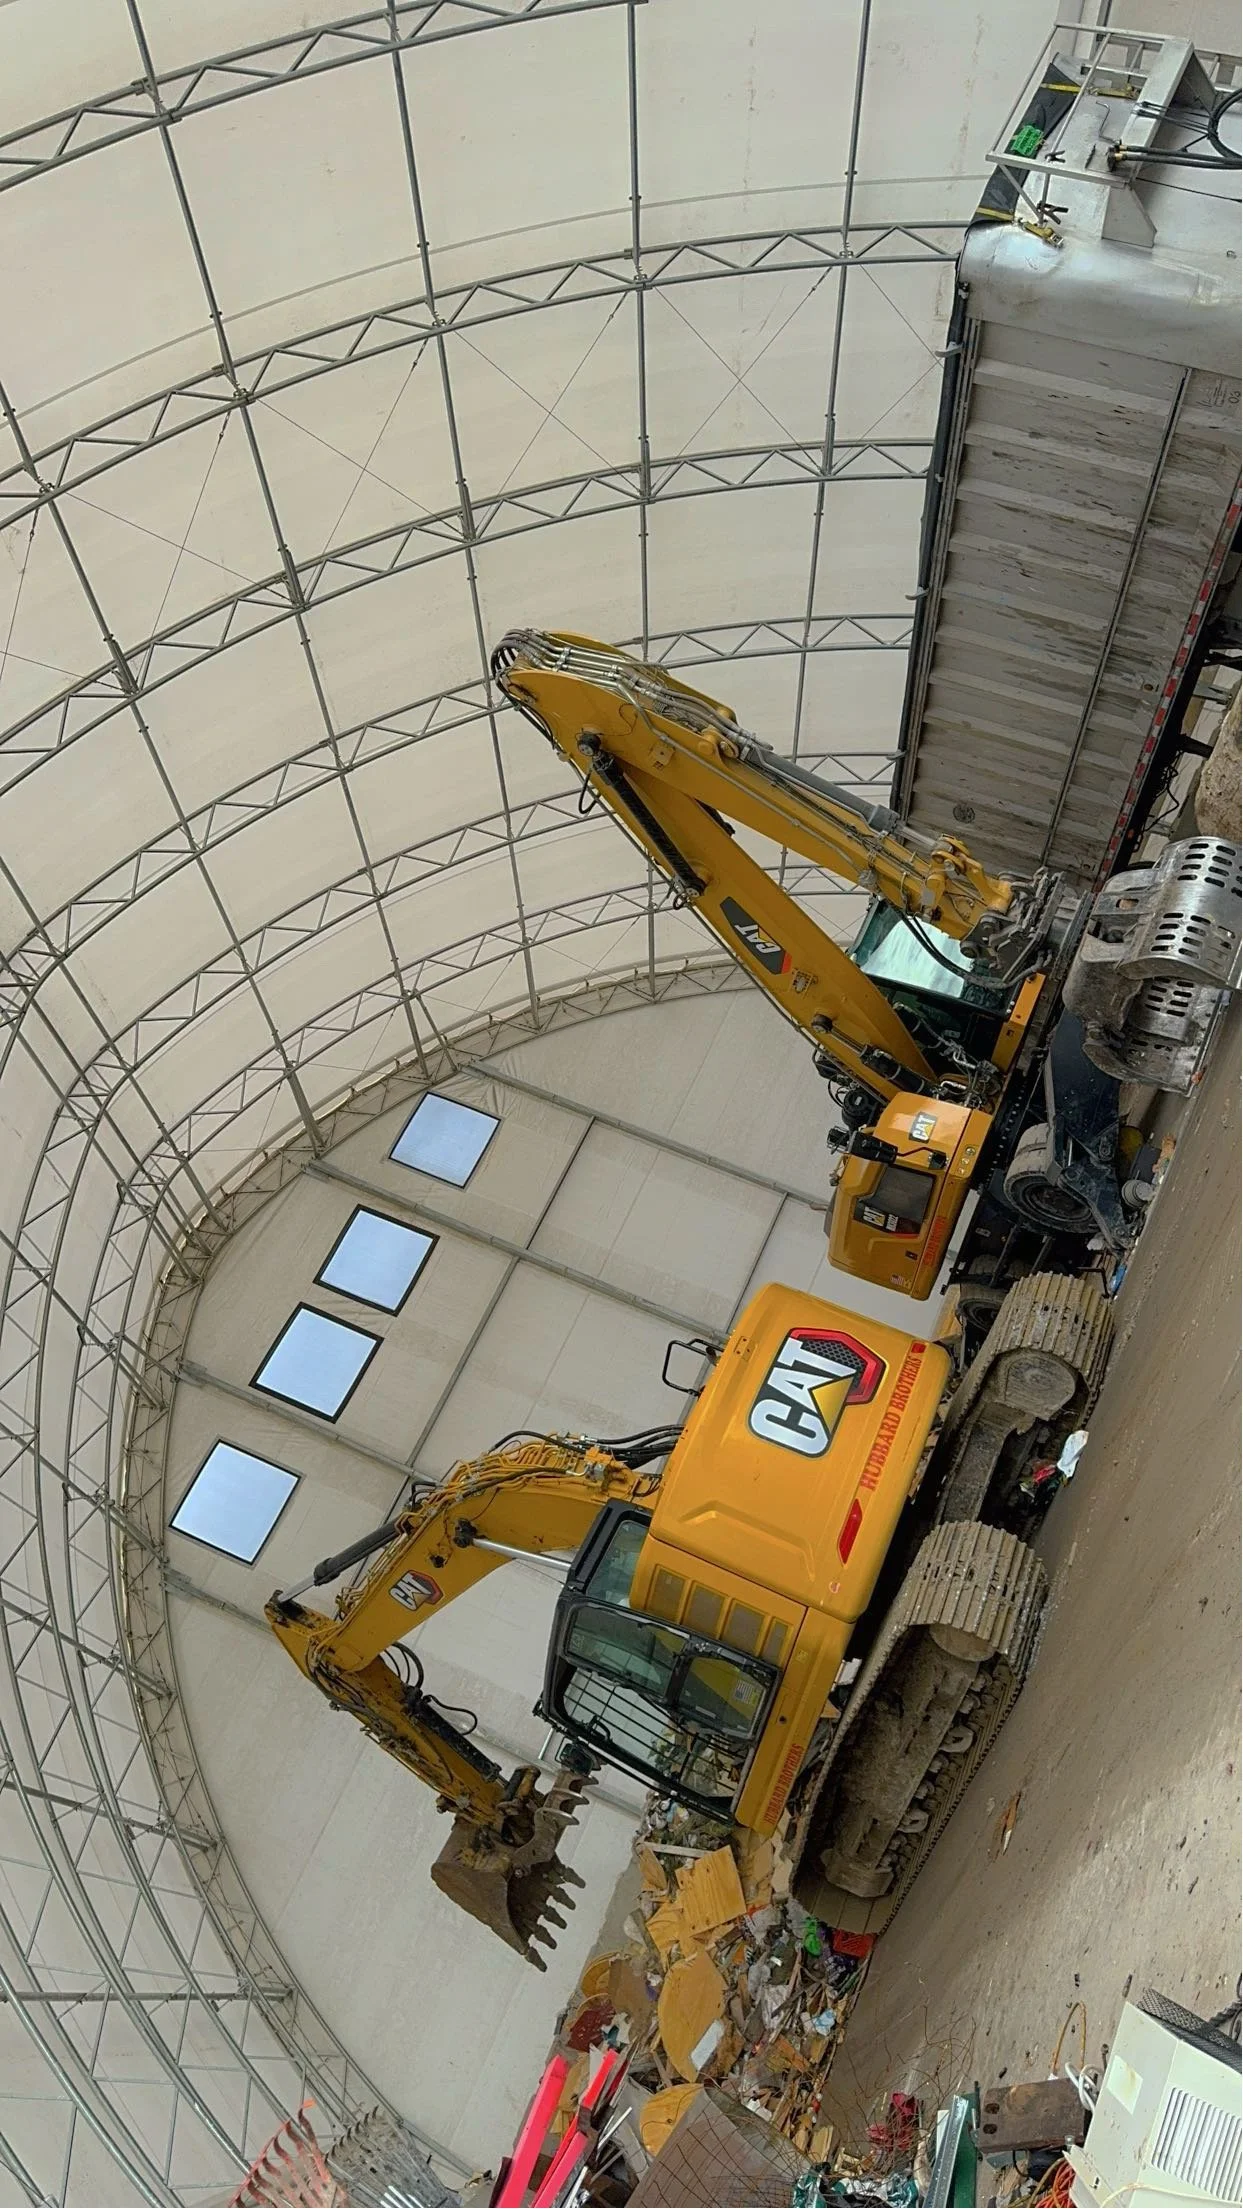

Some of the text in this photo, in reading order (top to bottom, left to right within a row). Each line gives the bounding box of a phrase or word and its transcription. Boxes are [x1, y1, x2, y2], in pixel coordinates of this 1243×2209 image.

[734, 924, 781, 954] CAT
[912, 1115, 937, 1141] CAT
[863, 1206, 886, 1227] CAT
[750, 1337, 857, 1455] CAT
[860, 1355, 923, 1492] HUBBARD BROTHERS
[390, 1572, 432, 1610] CAT
